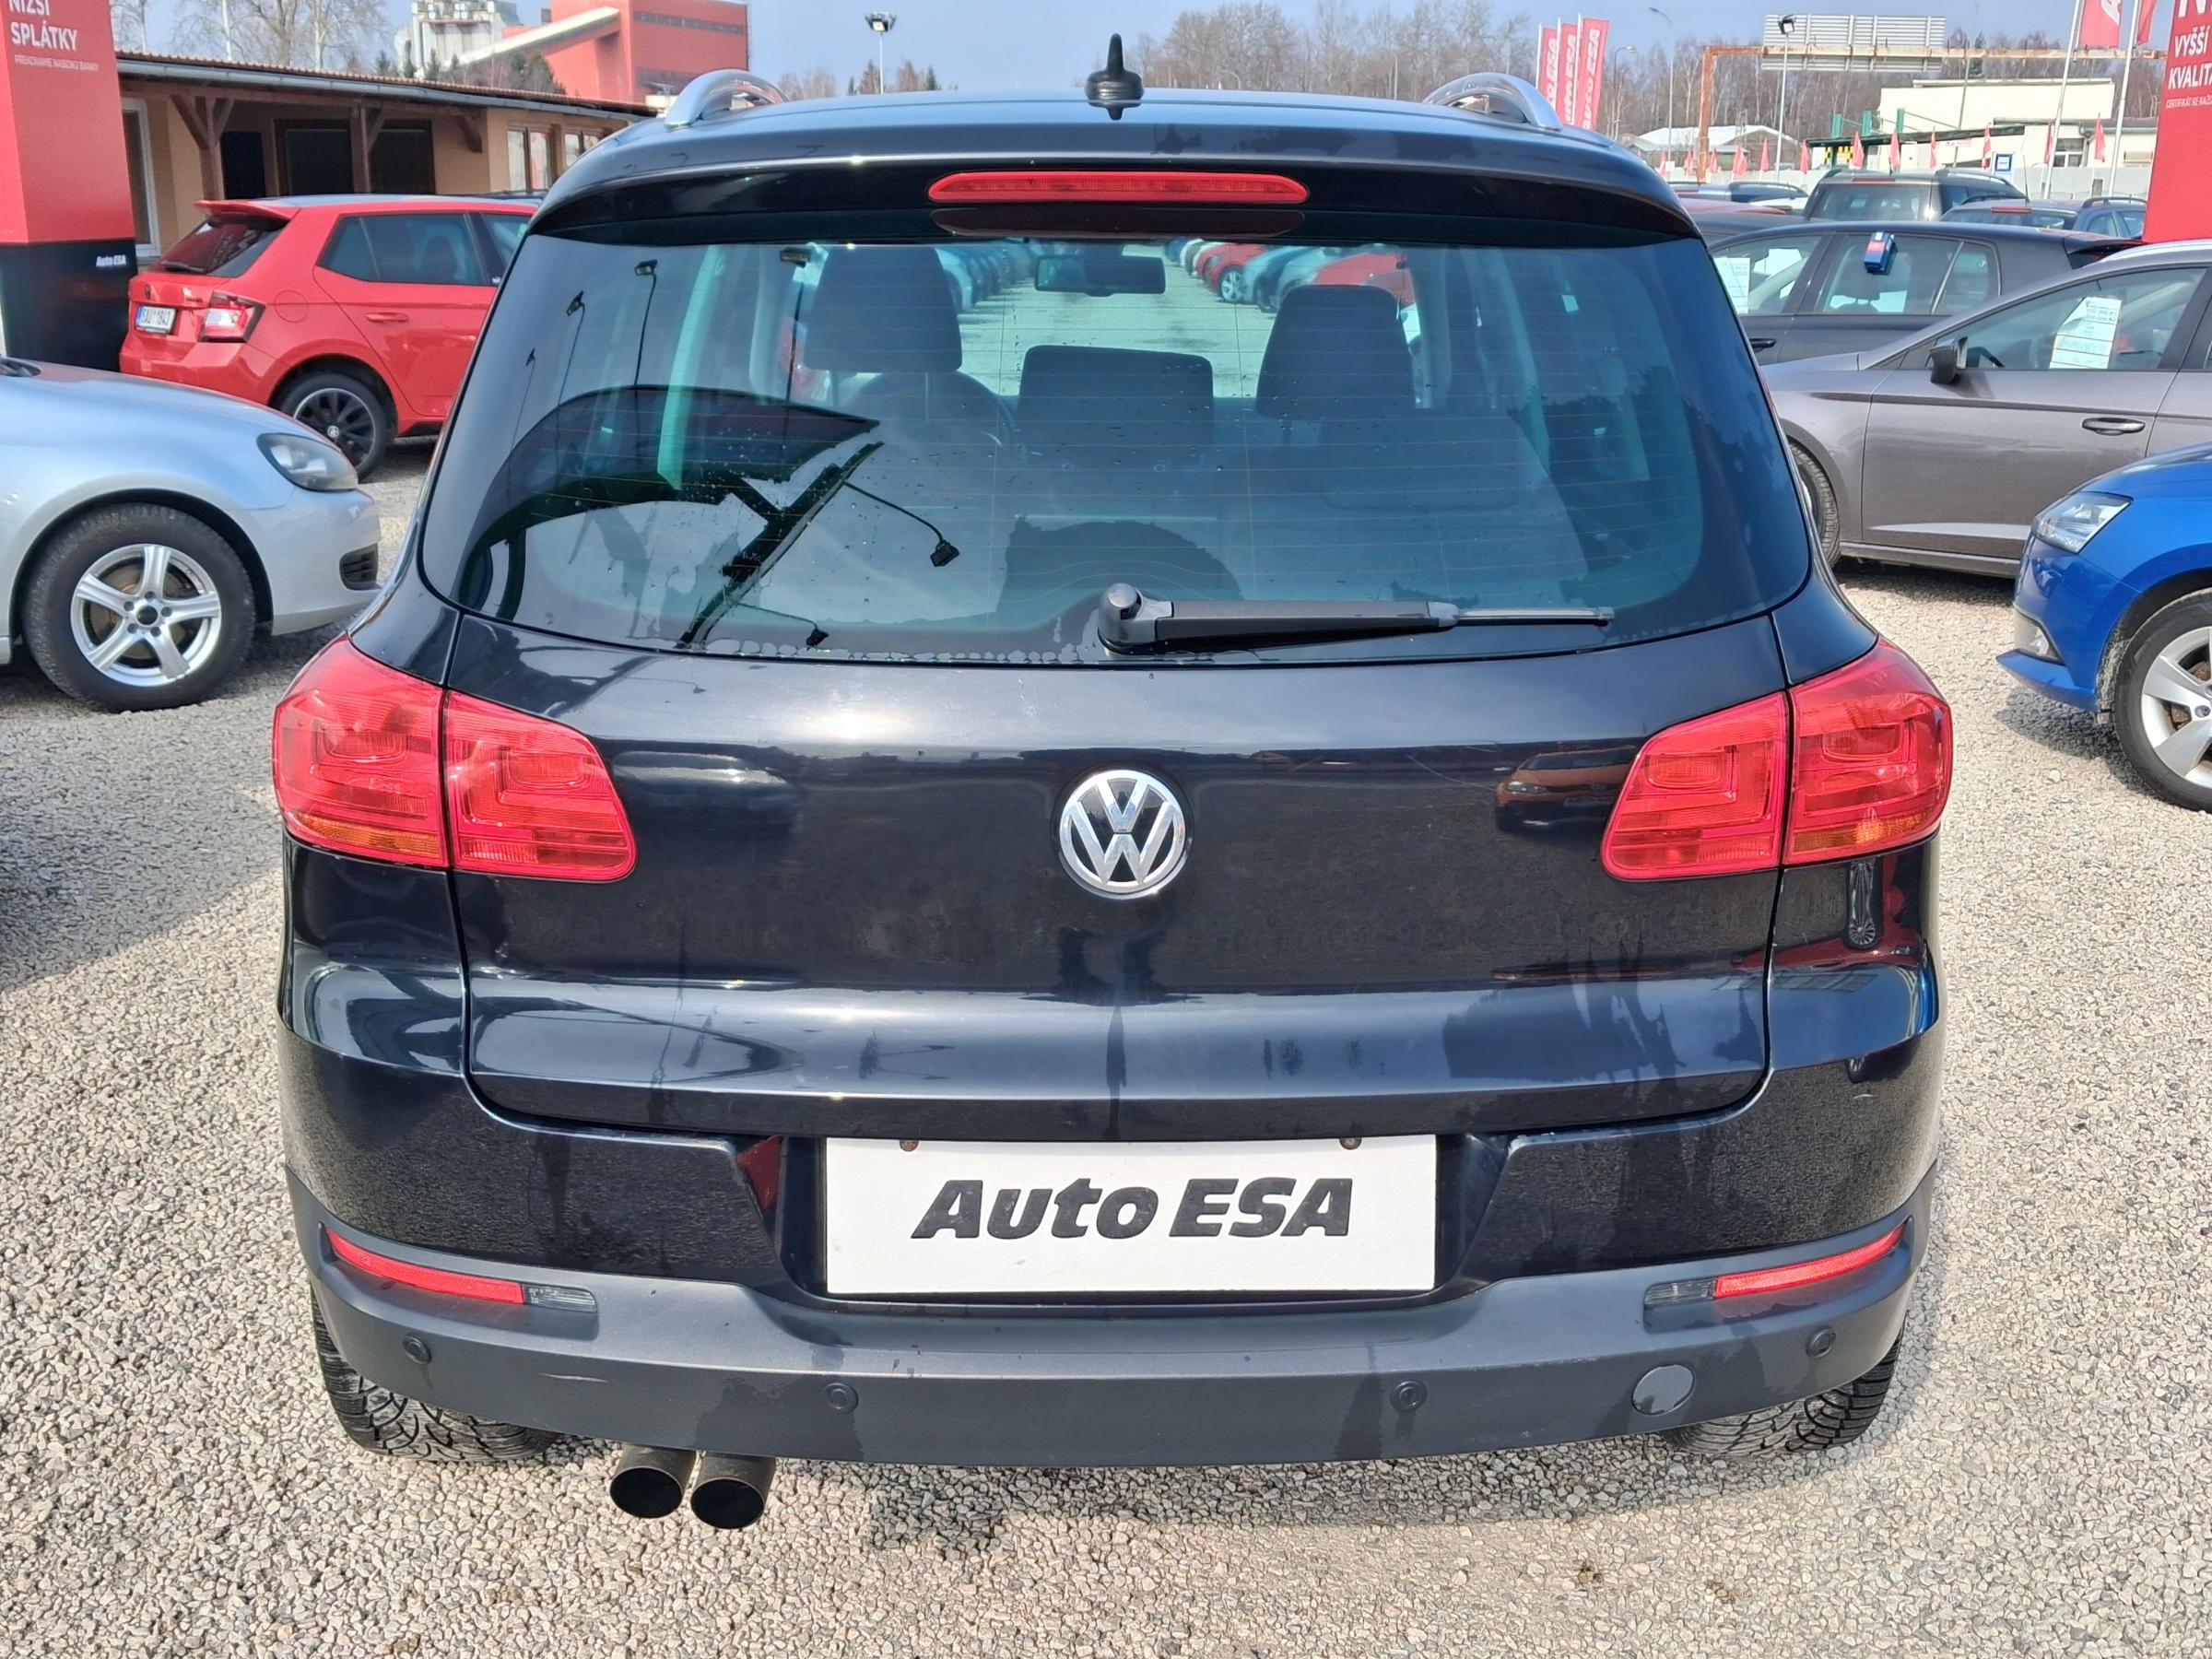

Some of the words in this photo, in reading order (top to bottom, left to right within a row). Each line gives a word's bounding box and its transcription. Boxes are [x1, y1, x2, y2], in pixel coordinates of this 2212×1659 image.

[10, 19, 78, 51] SPLÁTKY
[1587, 29, 1600, 76] ESA
[2174, 24, 2211, 57] VYŠŠÍ
[910, 1177, 1159, 1240] Auto
[1168, 1176, 1353, 1238] ESA
